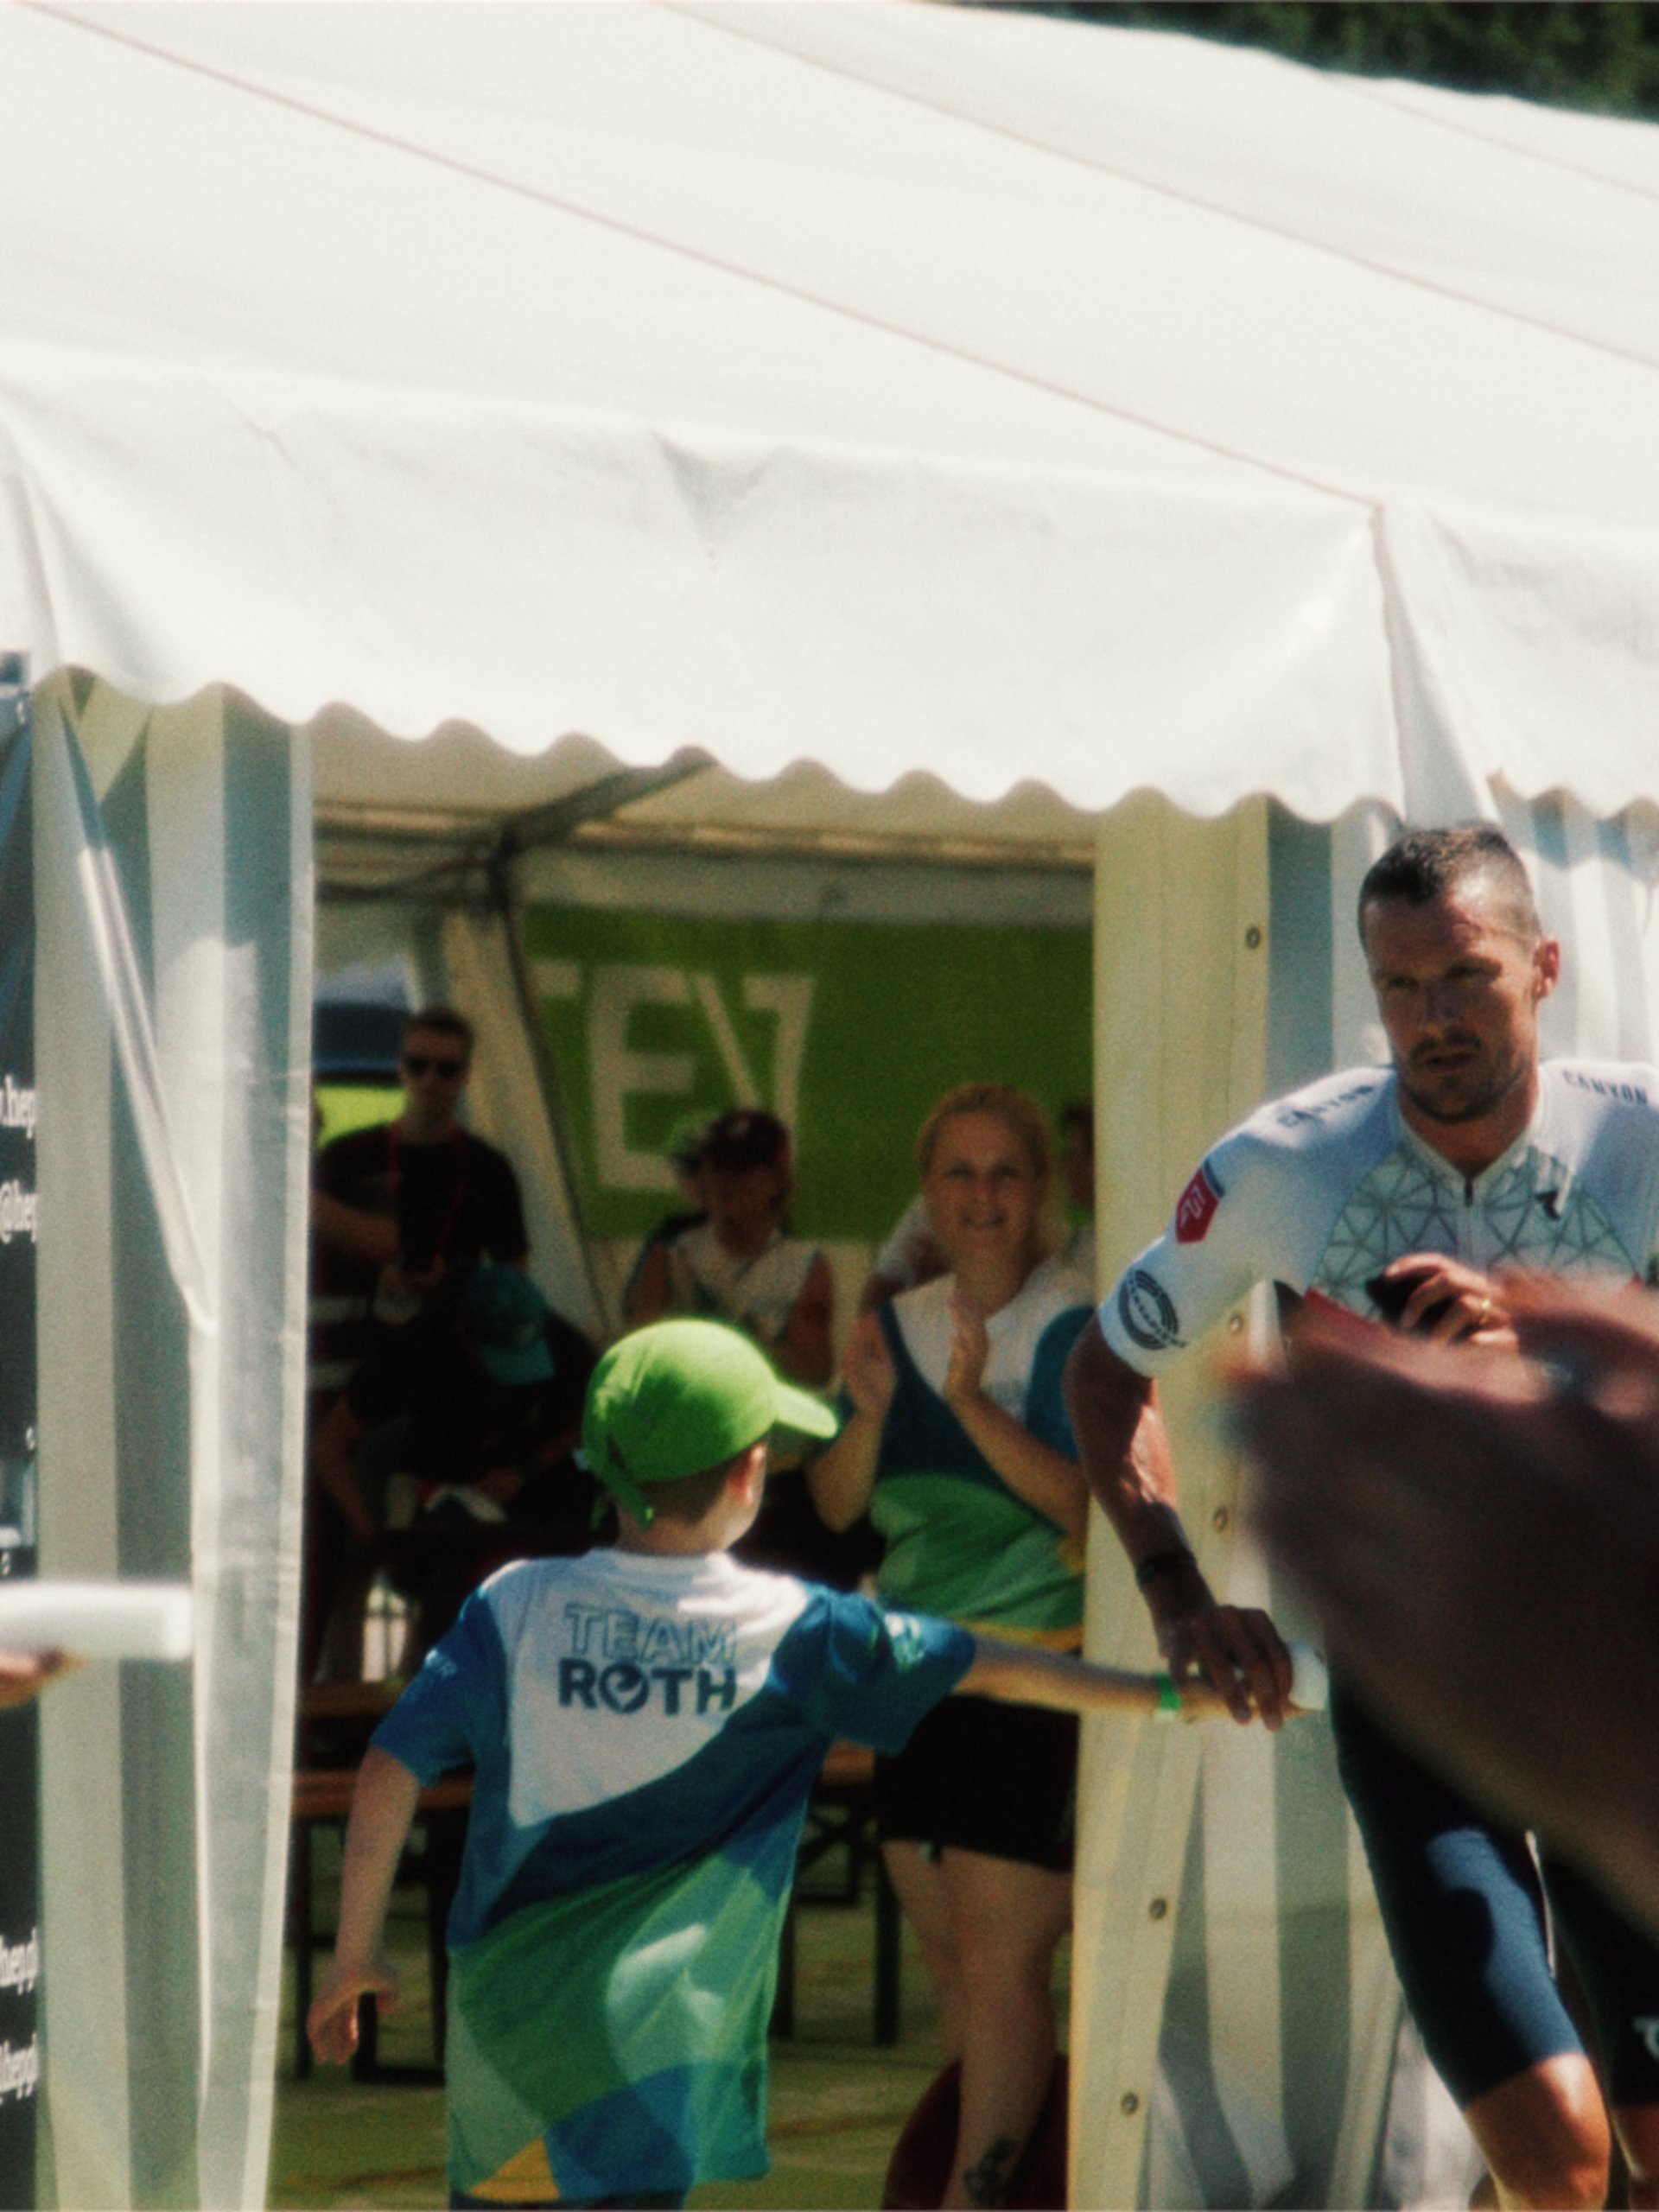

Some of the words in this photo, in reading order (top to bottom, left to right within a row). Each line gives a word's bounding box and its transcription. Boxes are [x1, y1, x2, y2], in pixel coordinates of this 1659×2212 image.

[1560, 1069, 1649, 1105] CANYON
[563, 1600, 737, 1667] TEAM
[558, 1656, 737, 1716] ROTH
